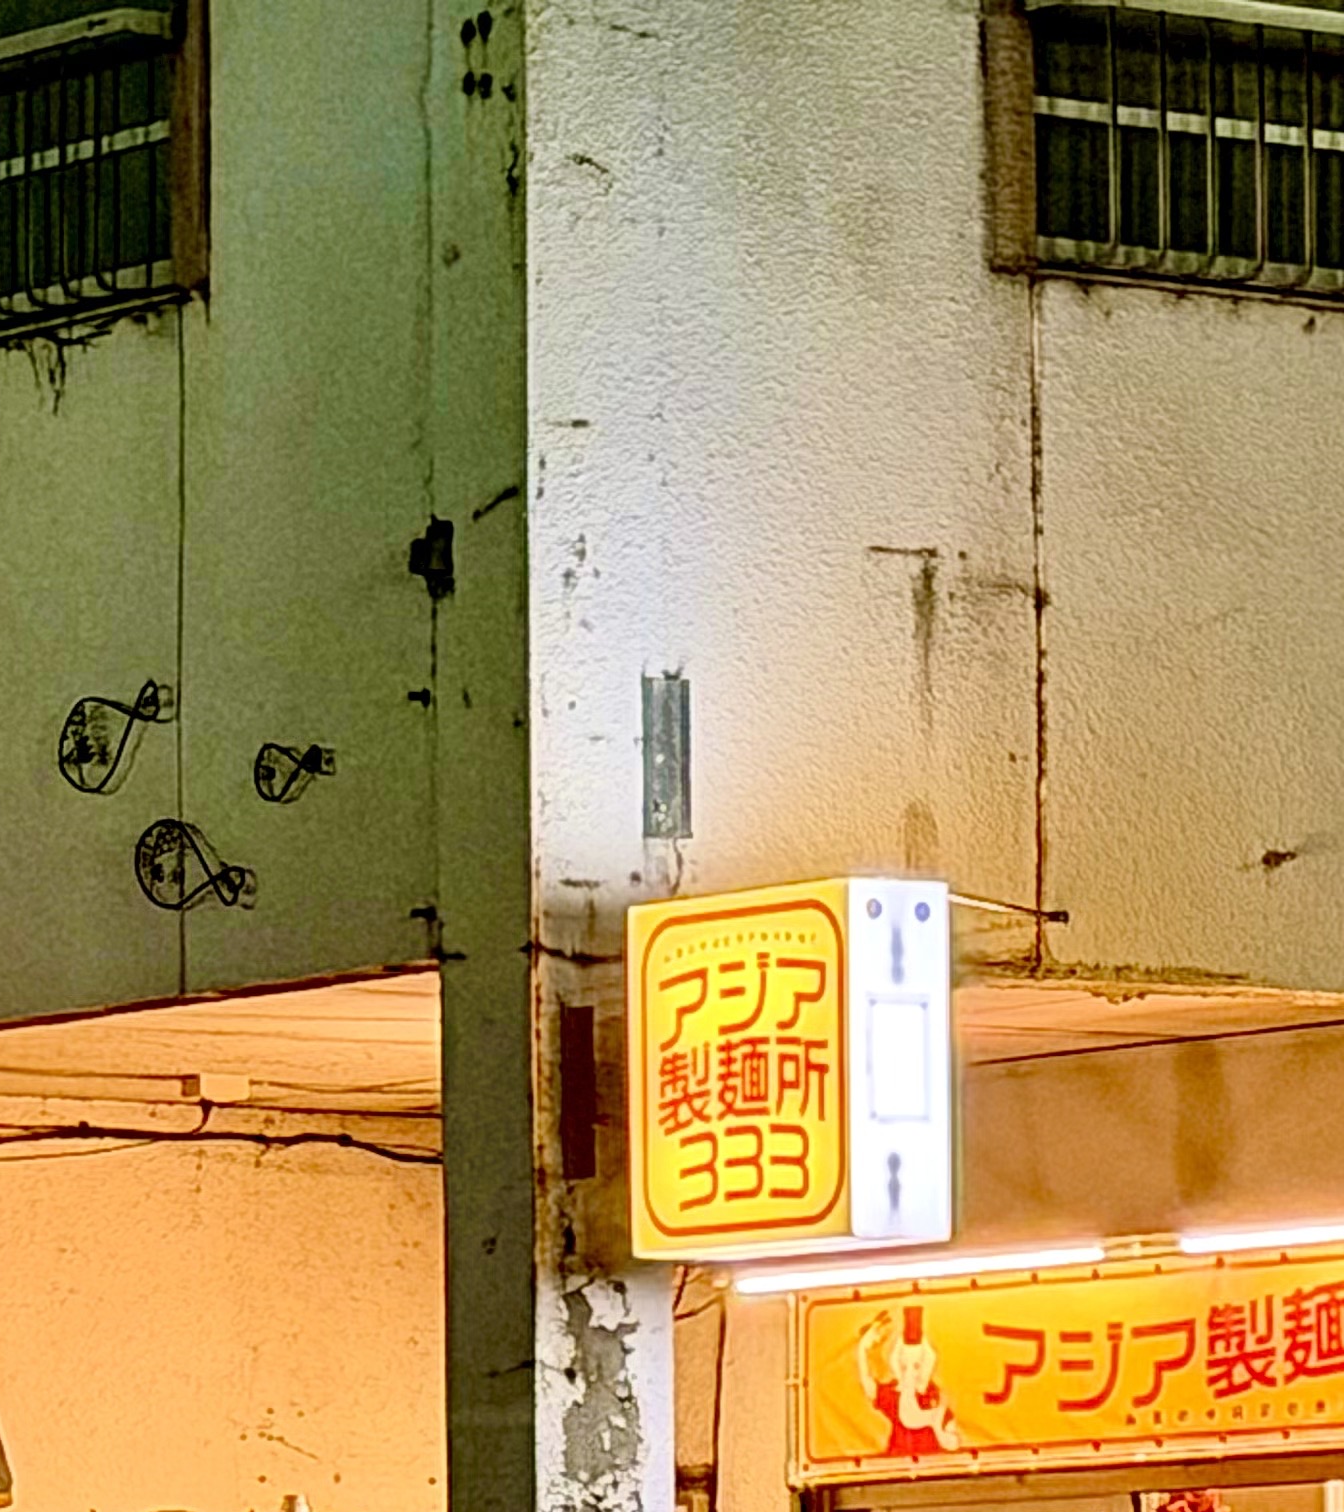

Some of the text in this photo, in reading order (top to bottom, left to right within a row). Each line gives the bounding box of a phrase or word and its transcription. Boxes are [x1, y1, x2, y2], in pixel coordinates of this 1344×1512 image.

[659, 951, 826, 1052] アジア
[658, 1037, 830, 1136] 製麺所
[679, 1123, 809, 1212] 333
